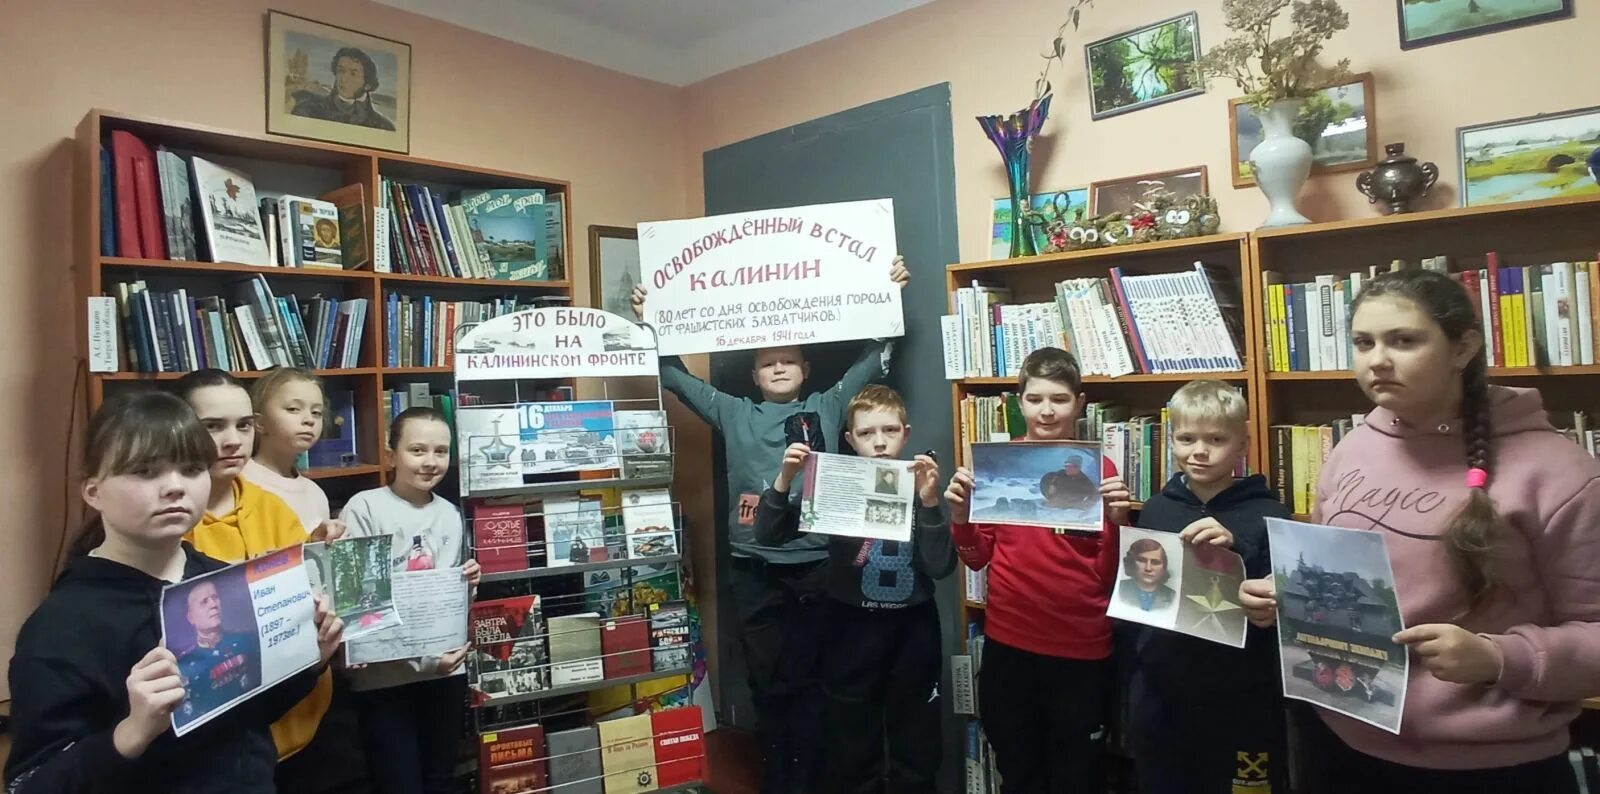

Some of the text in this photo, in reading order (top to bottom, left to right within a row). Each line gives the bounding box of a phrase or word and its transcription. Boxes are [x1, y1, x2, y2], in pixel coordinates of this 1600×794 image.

[653, 217, 878, 290] ОСВОБОЖДЁННЫЙ ВСТАЛ
[690, 259, 821, 291] КАЛИНИН
[700, 307, 715, 318] СО
[719, 303, 743, 317] ДНЯ
[748, 297, 842, 314] ОСВОБОЖДЕНИЯ
[846, 292, 892, 305] ГОРОДА
[512, 309, 607, 333] ЭТО БЫЛО
[658, 324, 673, 337] ОТ
[675, 318, 746, 336] ФАШИСТСКИХ
[555, 335, 583, 348] НА
[716, 336, 726, 347] 16
[727, 335, 767, 347] ДЕКАБРЯ
[772, 330, 792, 342] 1941
[467, 352, 646, 369] КАЛИНИНСКОМ ФРОНТЕ
[518, 404, 545, 430] 16
[253, 585, 276, 600] Иван
[257, 591, 311, 617] Степанович
[474, 617, 507, 628] ЗАВТРА
[475, 626, 502, 637] БЫЛА
[475, 633, 512, 645] ПОБЕДА
[490, 747, 533, 764] ПИСЬМА
